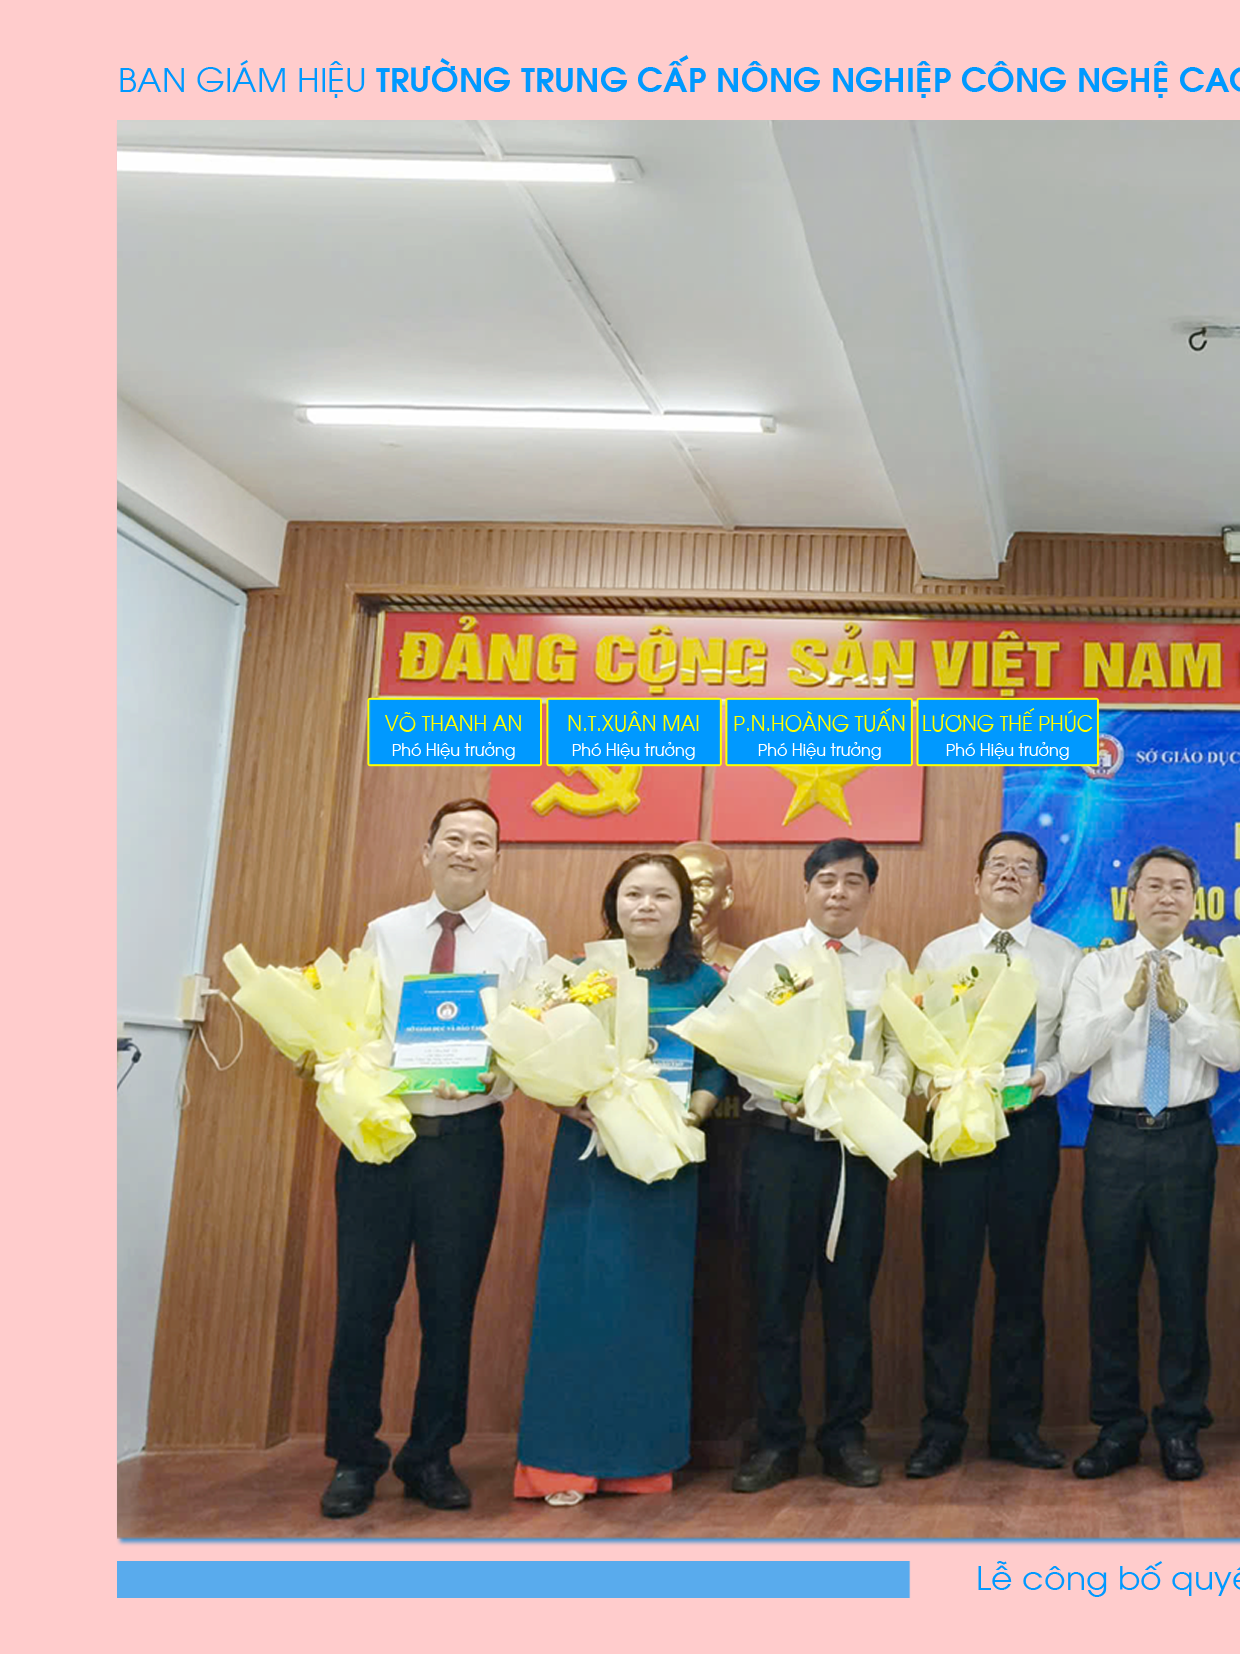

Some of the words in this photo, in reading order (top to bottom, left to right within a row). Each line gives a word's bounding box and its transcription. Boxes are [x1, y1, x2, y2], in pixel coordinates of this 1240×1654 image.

[399, 615, 578, 684] ĐẢNG
[594, 625, 767, 693] CỘNG
[787, 622, 916, 686] SẢN
[931, 630, 1060, 696] VIỆT
[1083, 641, 1223, 688] NAM
[1136, 748, 1158, 763] SỞ
[1161, 748, 1203, 763] GIÁO
[1207, 750, 1240, 766] DỤC
